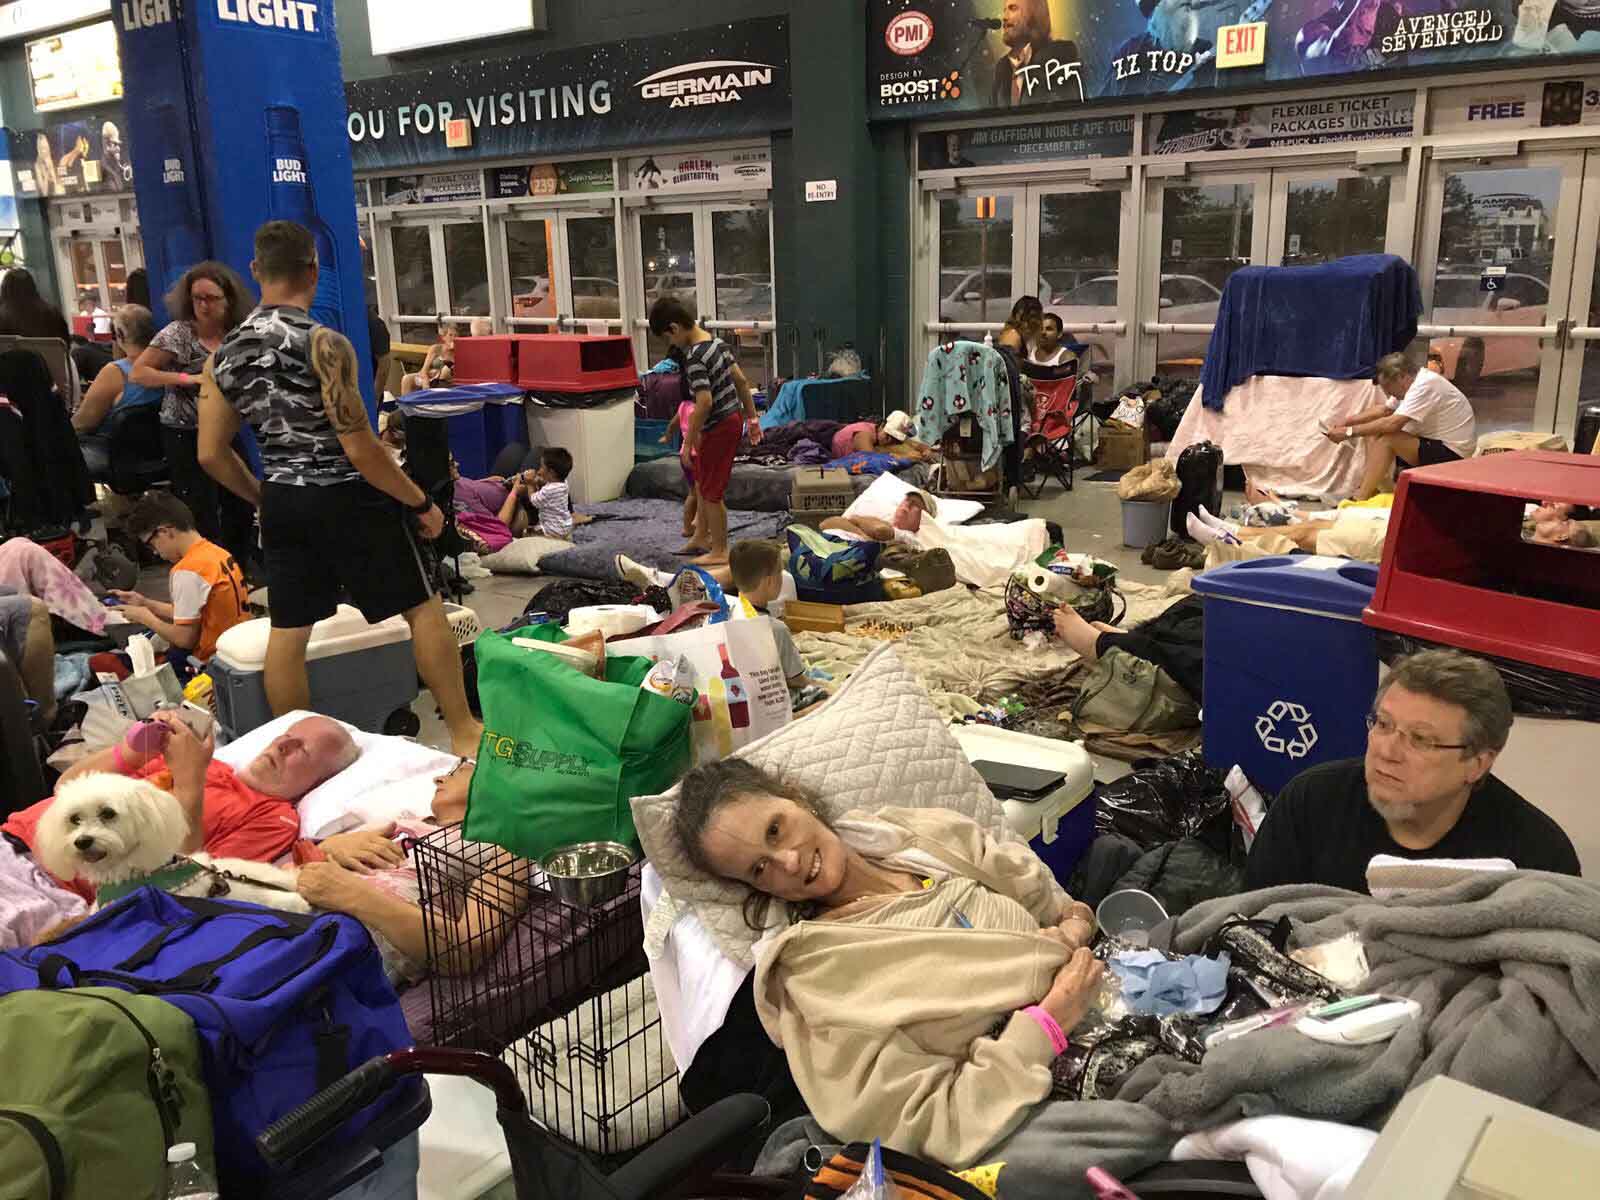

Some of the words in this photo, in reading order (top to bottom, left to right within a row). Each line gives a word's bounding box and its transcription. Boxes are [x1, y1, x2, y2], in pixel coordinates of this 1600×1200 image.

[122, 0, 172, 31] LIGH
[217, 0, 319, 32] LIGHT
[1394, 9, 1492, 36] AVENGED
[894, 24, 923, 43] PMI
[1225, 26, 1258, 55] EXIT
[1112, 54, 1141, 80] ZZ
[1147, 50, 1192, 74] TOP
[641, 68, 772, 99] GERMAIN
[880, 71, 909, 81] DESIGN
[912, 69, 923, 78] BY
[880, 79, 939, 97] BOOST
[669, 90, 742, 108] ARENA
[880, 93, 937, 105] CREATIVE
[1271, 102, 1334, 118] FLEXIBLE
[1340, 97, 1390, 112] TICKET
[347, 109, 385, 142] OU
[398, 101, 453, 136] FOR
[466, 79, 612, 128] VISITING
[1468, 101, 1526, 120] FREE
[991, 126, 1042, 143] GAFFIGAN
[1045, 123, 1080, 140] NOBLE
[1083, 120, 1105, 136] APE
[1270, 116, 1345, 133] PACKAGES
[1018, 142, 1071, 153] DECEMBER
[276, 158, 302, 170] BUD
[678, 159, 713, 173] HARLEM
[163, 170, 185, 183] LIGHT
[272, 170, 307, 183] LIGHT
[816, 183, 826, 191] NO
